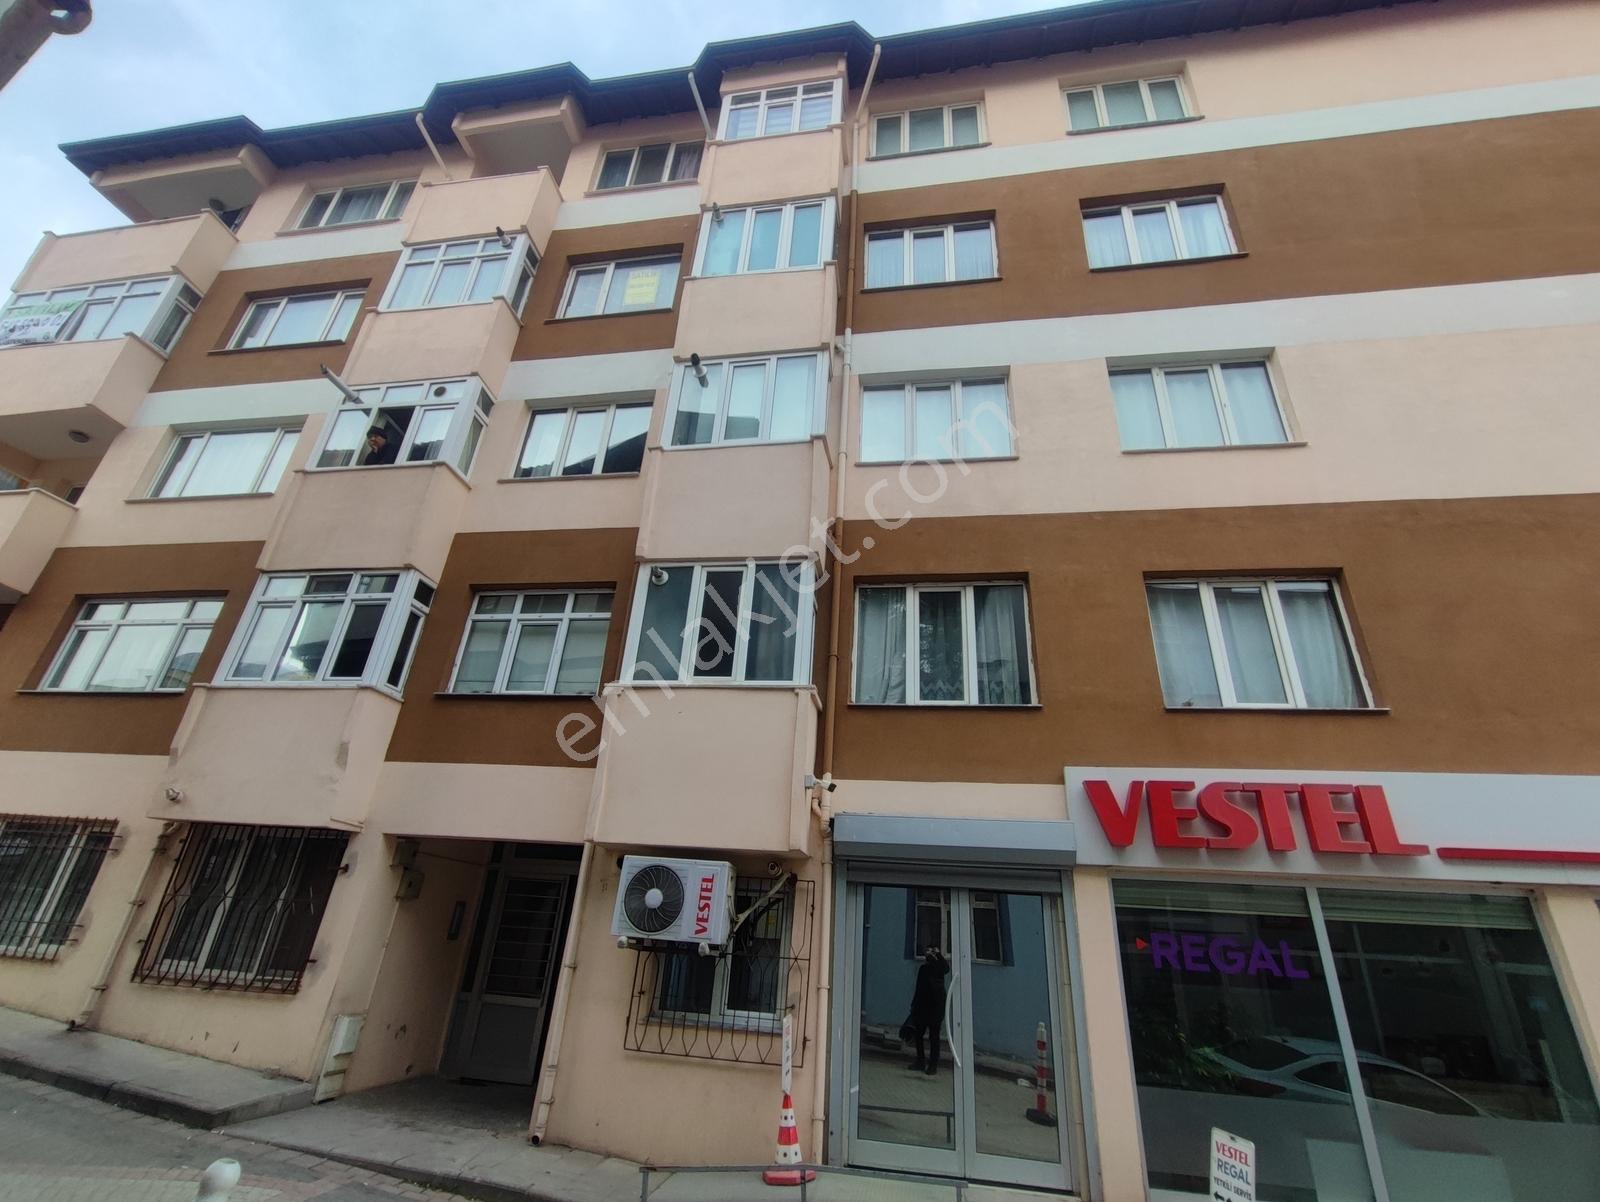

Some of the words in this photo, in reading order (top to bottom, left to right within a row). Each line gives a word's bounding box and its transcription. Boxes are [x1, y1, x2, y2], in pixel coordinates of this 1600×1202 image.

[1082, 780, 1430, 857] VESTEL
[694, 873, 715, 935] VESTEL
[1151, 932, 1311, 979] REGAL
[1215, 1140, 1250, 1167] VESTEL
[1217, 1158, 1252, 1186] REGAL
